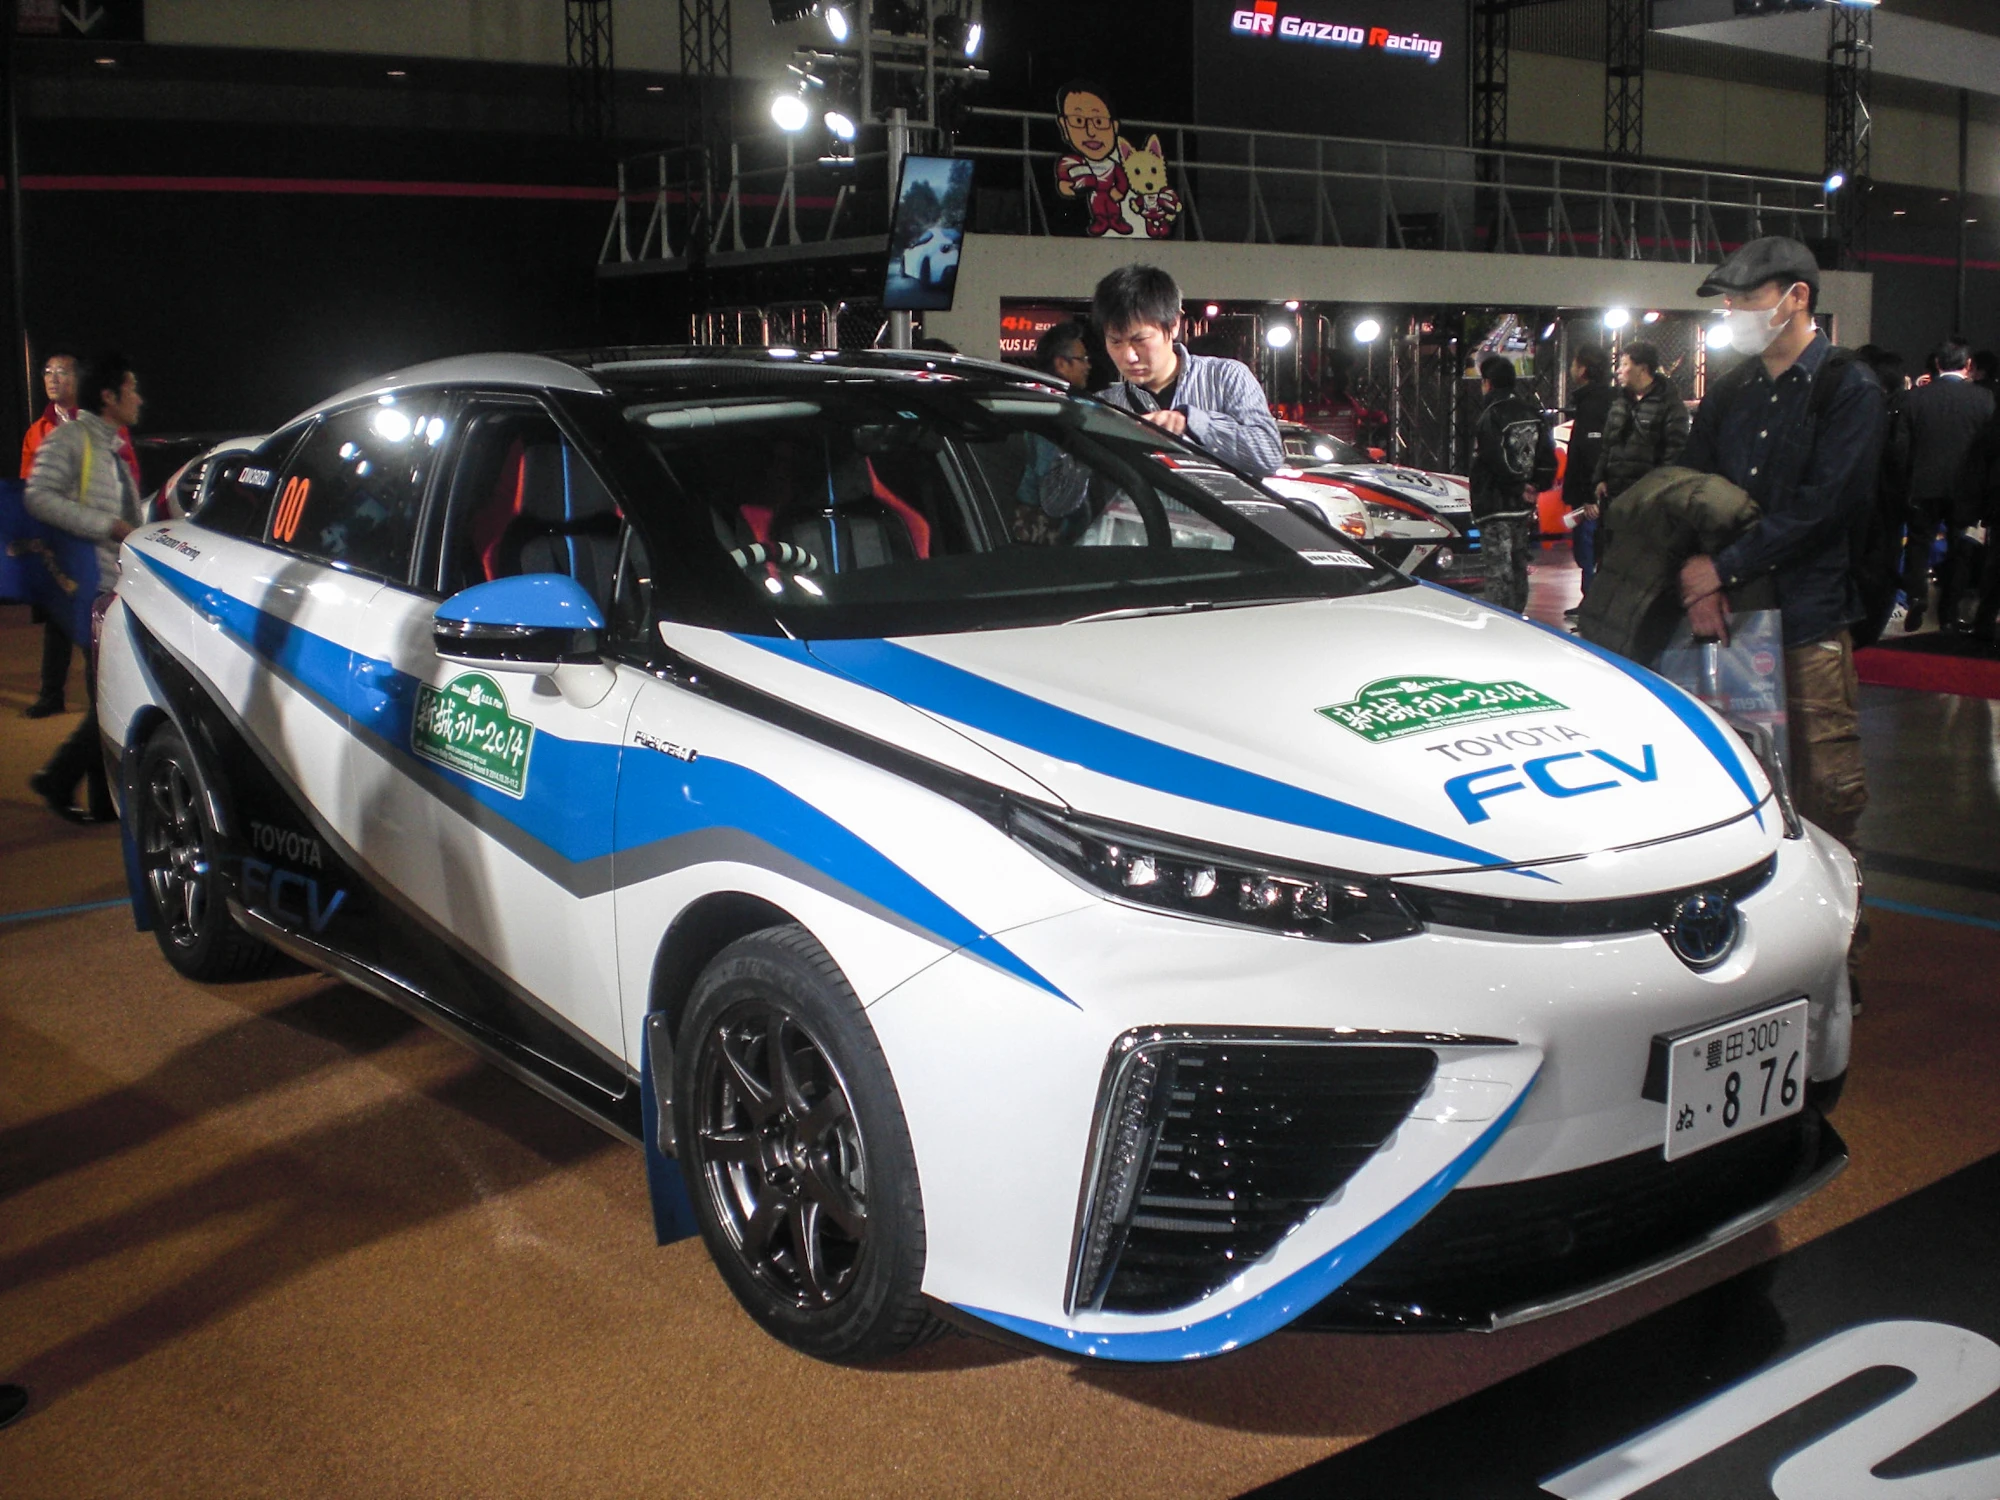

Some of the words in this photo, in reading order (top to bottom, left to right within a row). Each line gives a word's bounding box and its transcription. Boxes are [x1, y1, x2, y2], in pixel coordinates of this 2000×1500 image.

[1233, 11, 1274, 33] GR
[1280, 17, 1364, 43] GAZOO
[1369, 28, 1442, 58] Racing
[273, 475, 311, 543] 00
[1426, 724, 1590, 762] TOYOTA
[1444, 744, 1658, 825] FCV
[250, 821, 322, 868] TOYOTA
[242, 856, 347, 934] FCV
